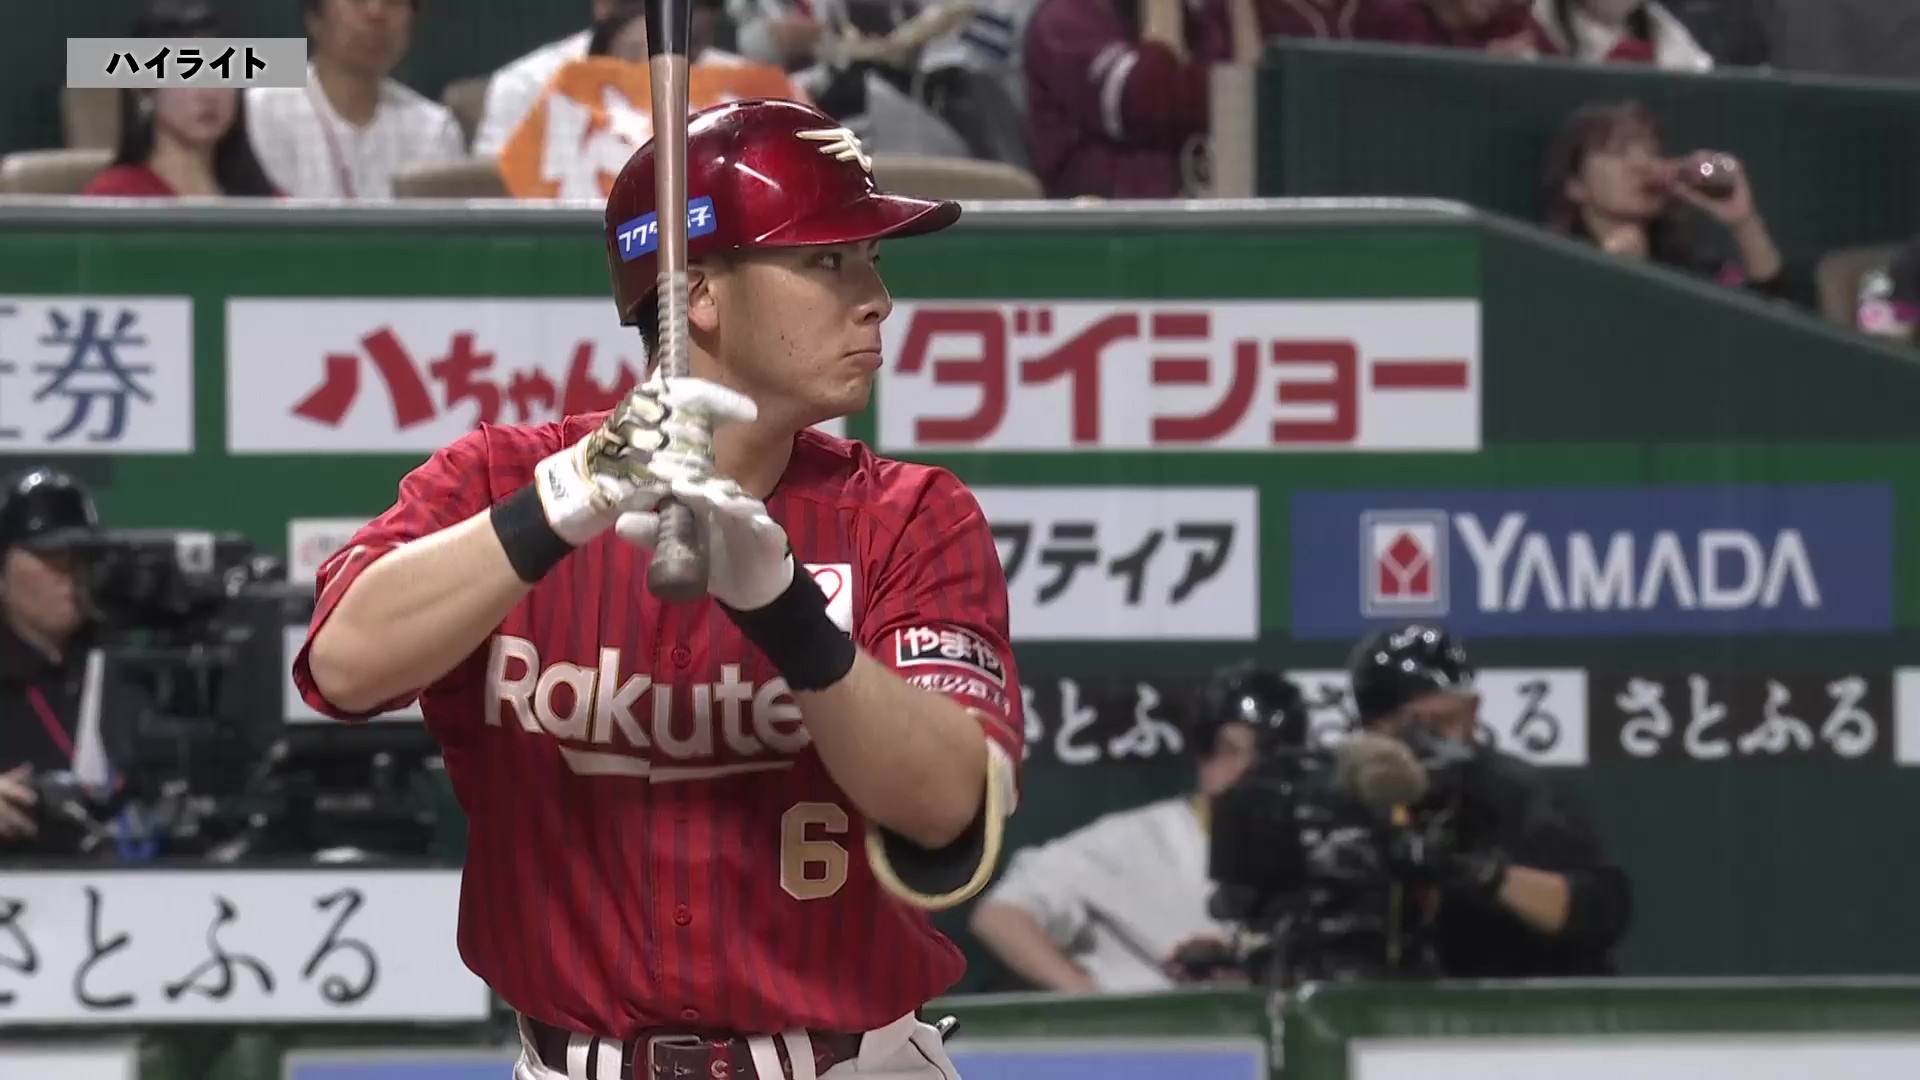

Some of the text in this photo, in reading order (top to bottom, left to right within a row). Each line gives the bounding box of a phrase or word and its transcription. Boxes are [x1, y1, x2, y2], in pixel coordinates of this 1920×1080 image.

[618, 205, 712, 253] フク子
[894, 309, 1469, 445] ダイショー
[1453, 511, 1822, 613] YAMADA
[485, 634, 812, 758] Rakute
[903, 626, 999, 670] やまや
[1615, 671, 1878, 760] さとふる
[779, 801, 849, 901] 6
